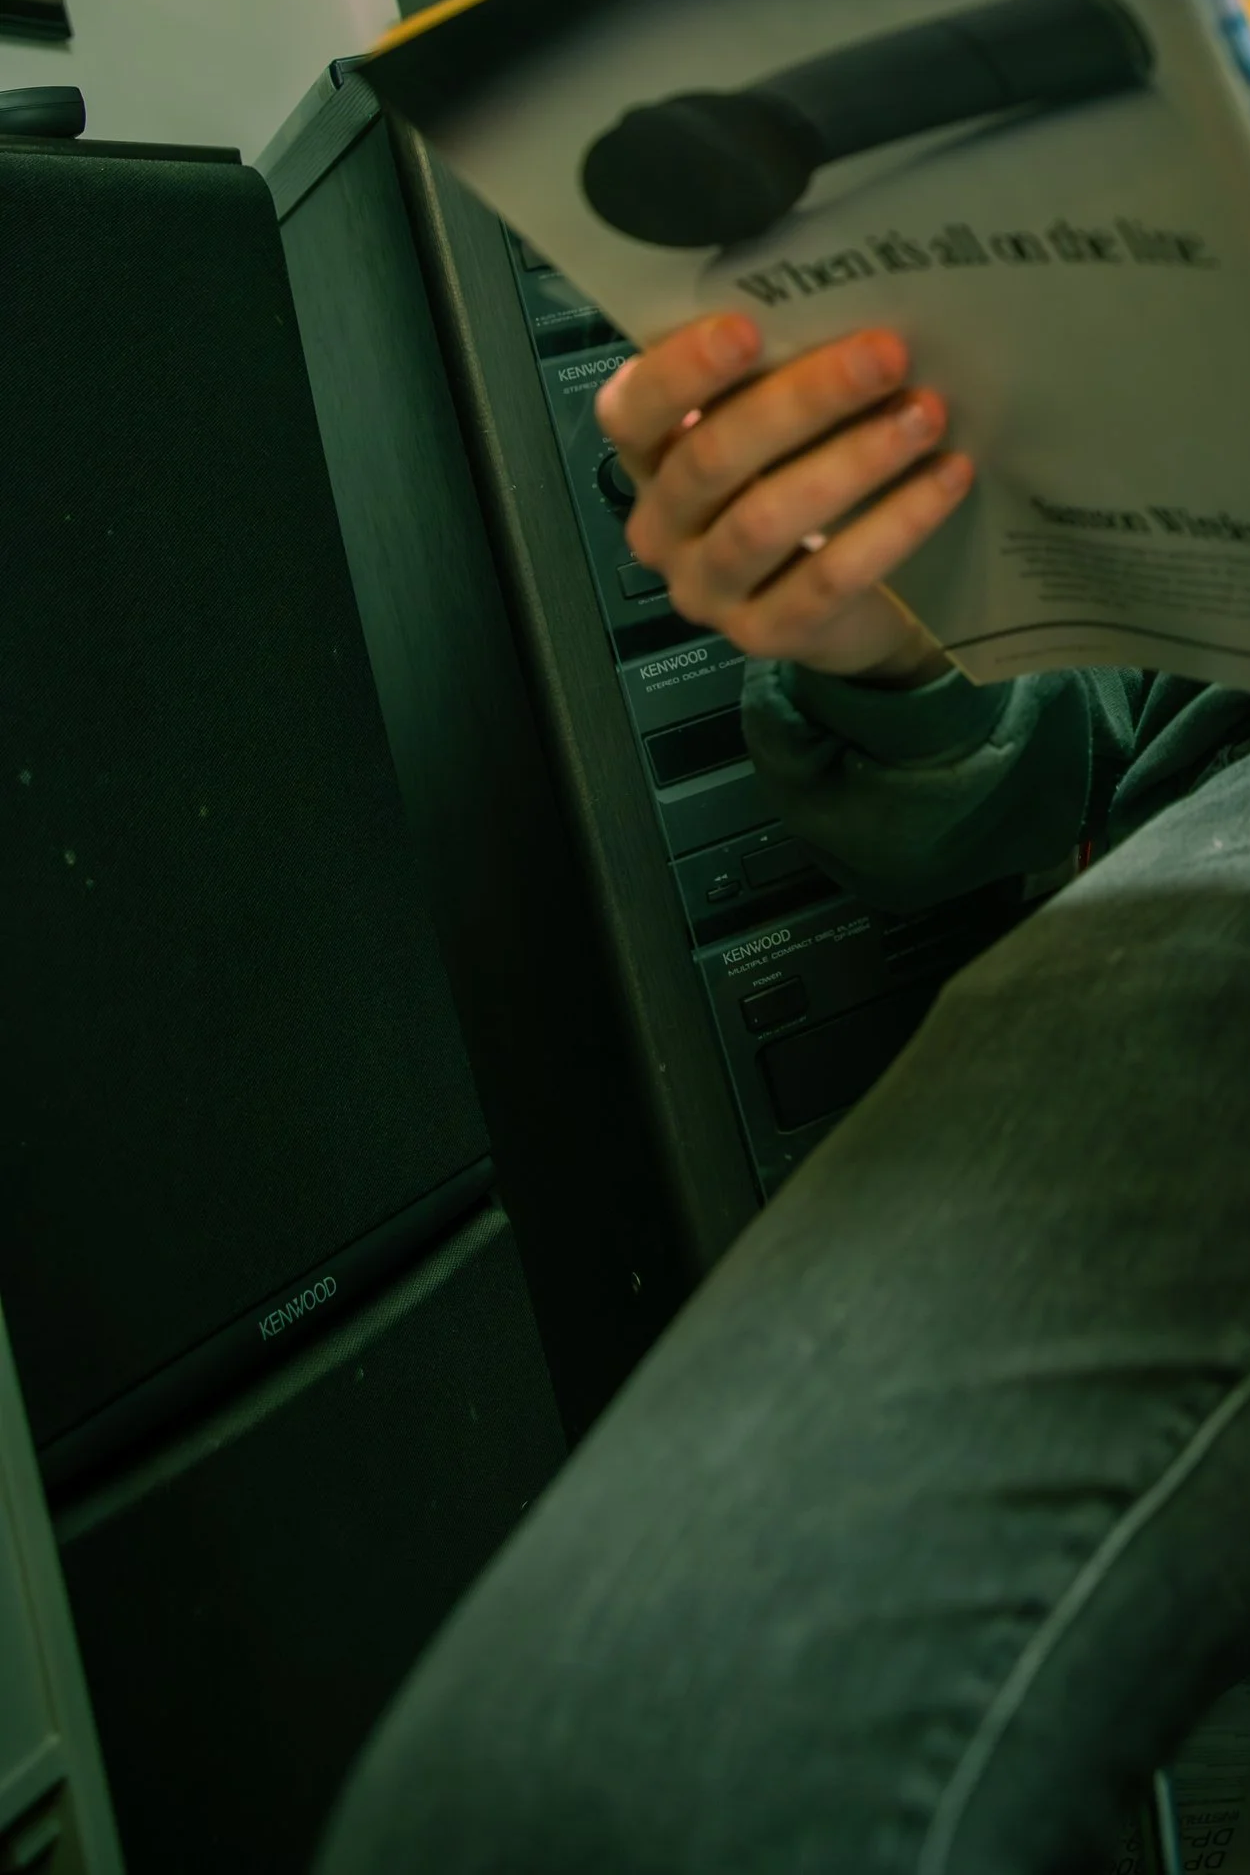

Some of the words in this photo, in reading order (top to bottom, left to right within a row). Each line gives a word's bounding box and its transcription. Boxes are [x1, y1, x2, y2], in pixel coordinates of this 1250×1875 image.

[736, 247, 878, 308] When
[929, 223, 990, 269] all
[990, 229, 1050, 266] on
[1045, 218, 1122, 267] the
[558, 356, 626, 382] KENWOOD
[640, 648, 709, 679] KENWOOD
[646, 676, 681, 693] STEREO
[682, 665, 717, 682] DOUBLE
[722, 928, 792, 966] KENWOOD
[728, 955, 769, 977] MULTIPLE
[771, 938, 814, 960] COMPACT
[752, 970, 783, 988] POWER
[258, 1276, 337, 1341] KENWOOD
